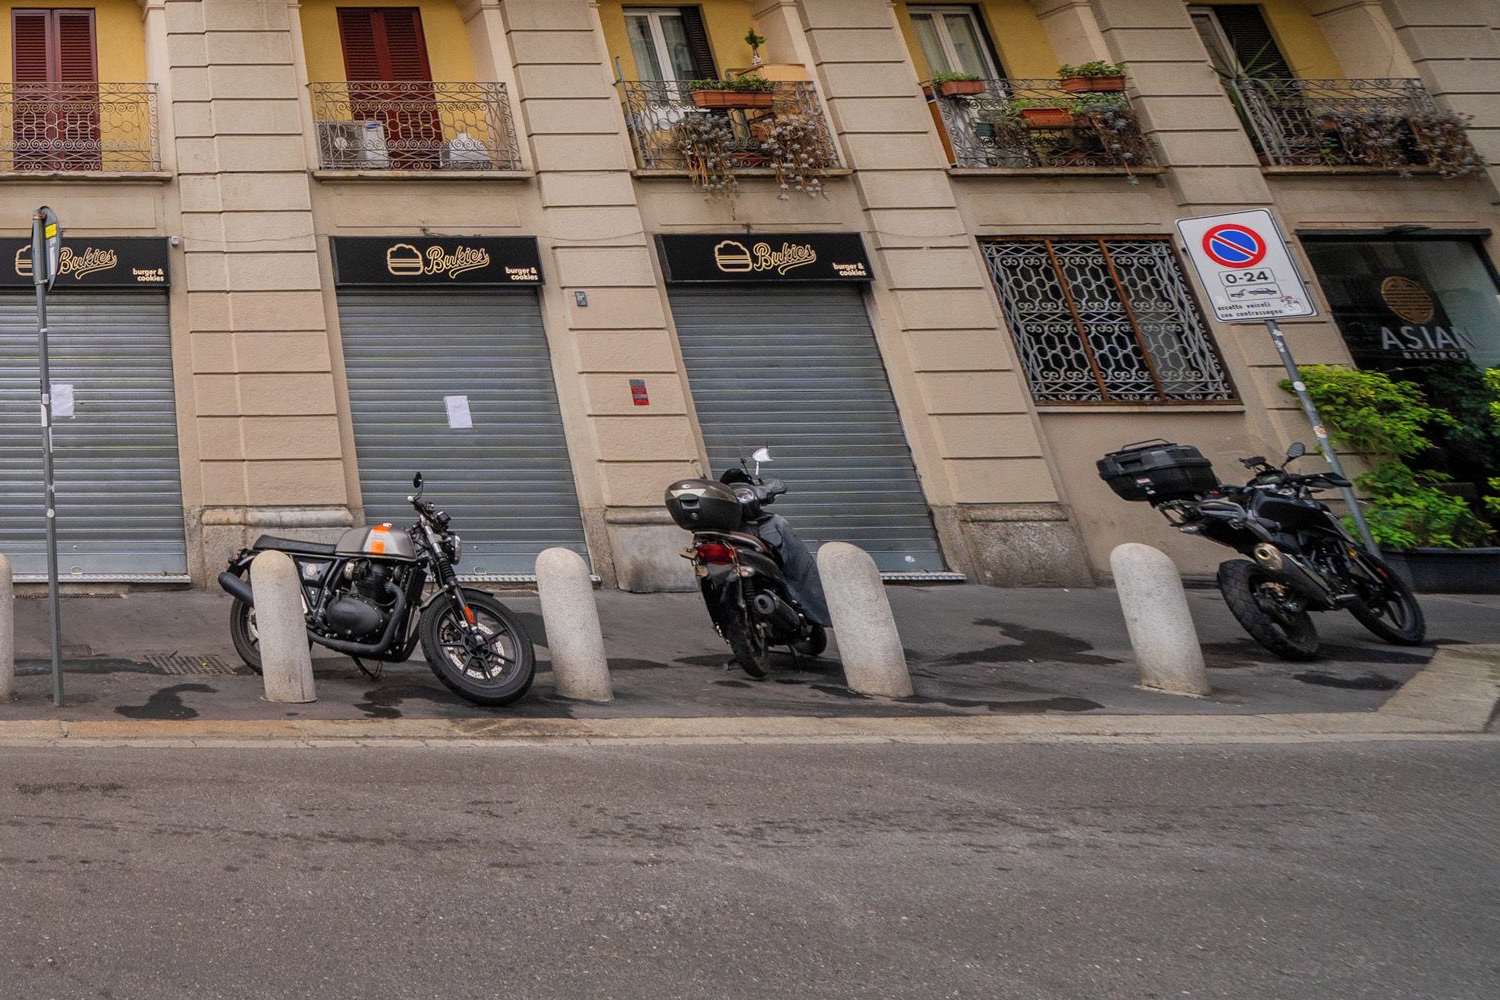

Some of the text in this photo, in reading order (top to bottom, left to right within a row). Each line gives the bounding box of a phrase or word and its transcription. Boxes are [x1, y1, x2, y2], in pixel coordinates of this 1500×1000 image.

[424, 245, 490, 279] Bukies
[753, 242, 817, 276] Bukies
[505, 266, 530, 275] burger
[832, 262, 858, 271] burger
[132, 268, 157, 276] burger
[511, 273, 539, 281] cookies
[1225, 270, 1269, 284] 0-24
[1246, 301, 1271, 309] veicoli
[1236, 308, 1283, 317] contrassegno
[1381, 326, 1477, 350] ASIAN
[1402, 350, 1470, 360] BISTROT
